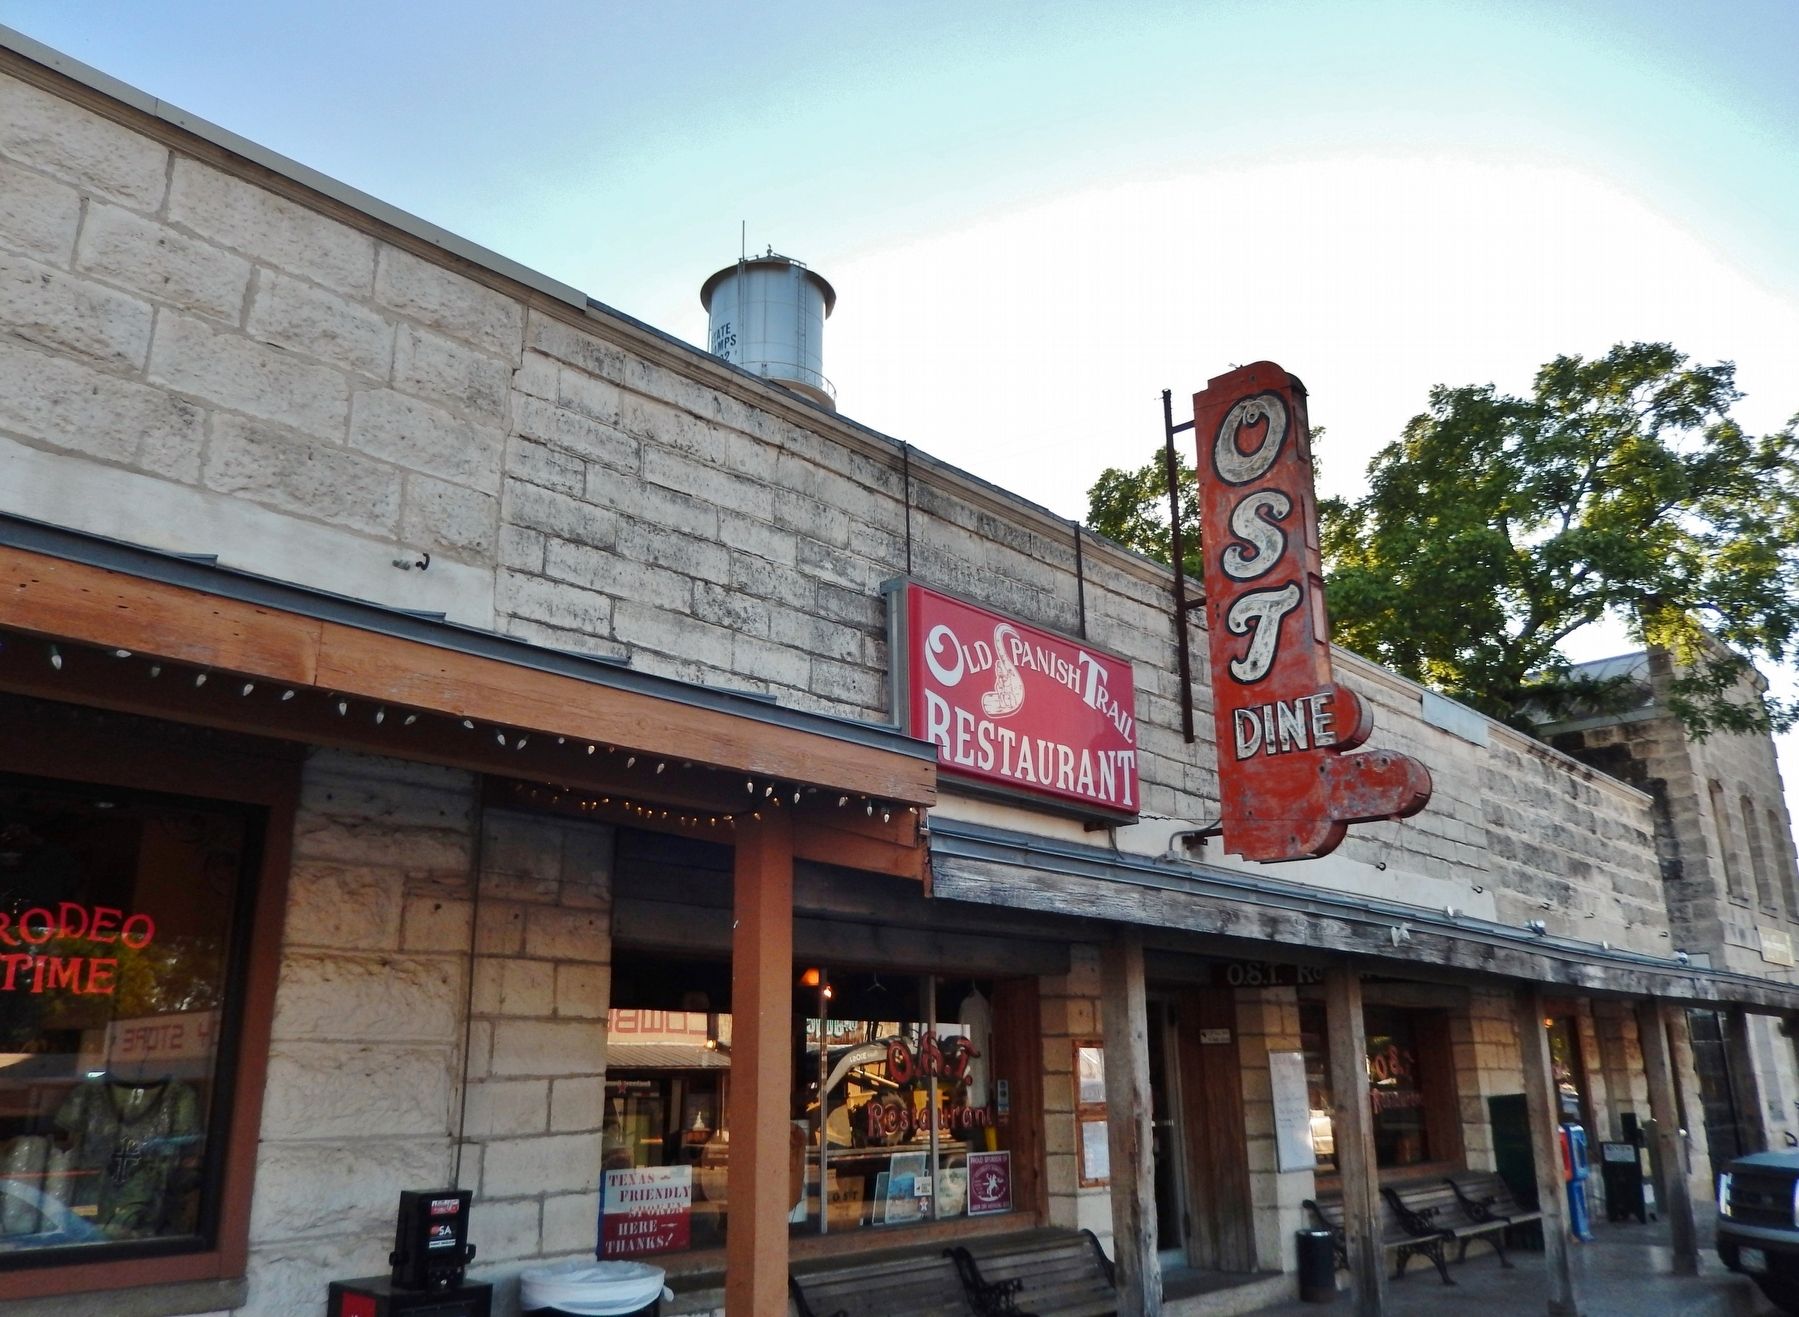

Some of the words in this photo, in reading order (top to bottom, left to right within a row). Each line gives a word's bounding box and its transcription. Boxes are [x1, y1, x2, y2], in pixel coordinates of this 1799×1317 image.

[711, 321, 731, 344] TATE
[981, 623, 1081, 719] SPANISH
[1079, 650, 1133, 744] TRAIL
[1233, 691, 1337, 761] DINE
[925, 688, 1135, 806] RESTAURANT
[0, 901, 156, 949] RODEO
[0, 952, 118, 994] TIME
[867, 1101, 993, 1137] Restaurant
[608, 1172, 655, 1187] TEXAS
[619, 1185, 691, 1203] FRIENDLY
[628, 1202, 684, 1218] SPOKEN
[618, 1219, 657, 1236] HERE
[605, 1233, 674, 1254] THANKS!
